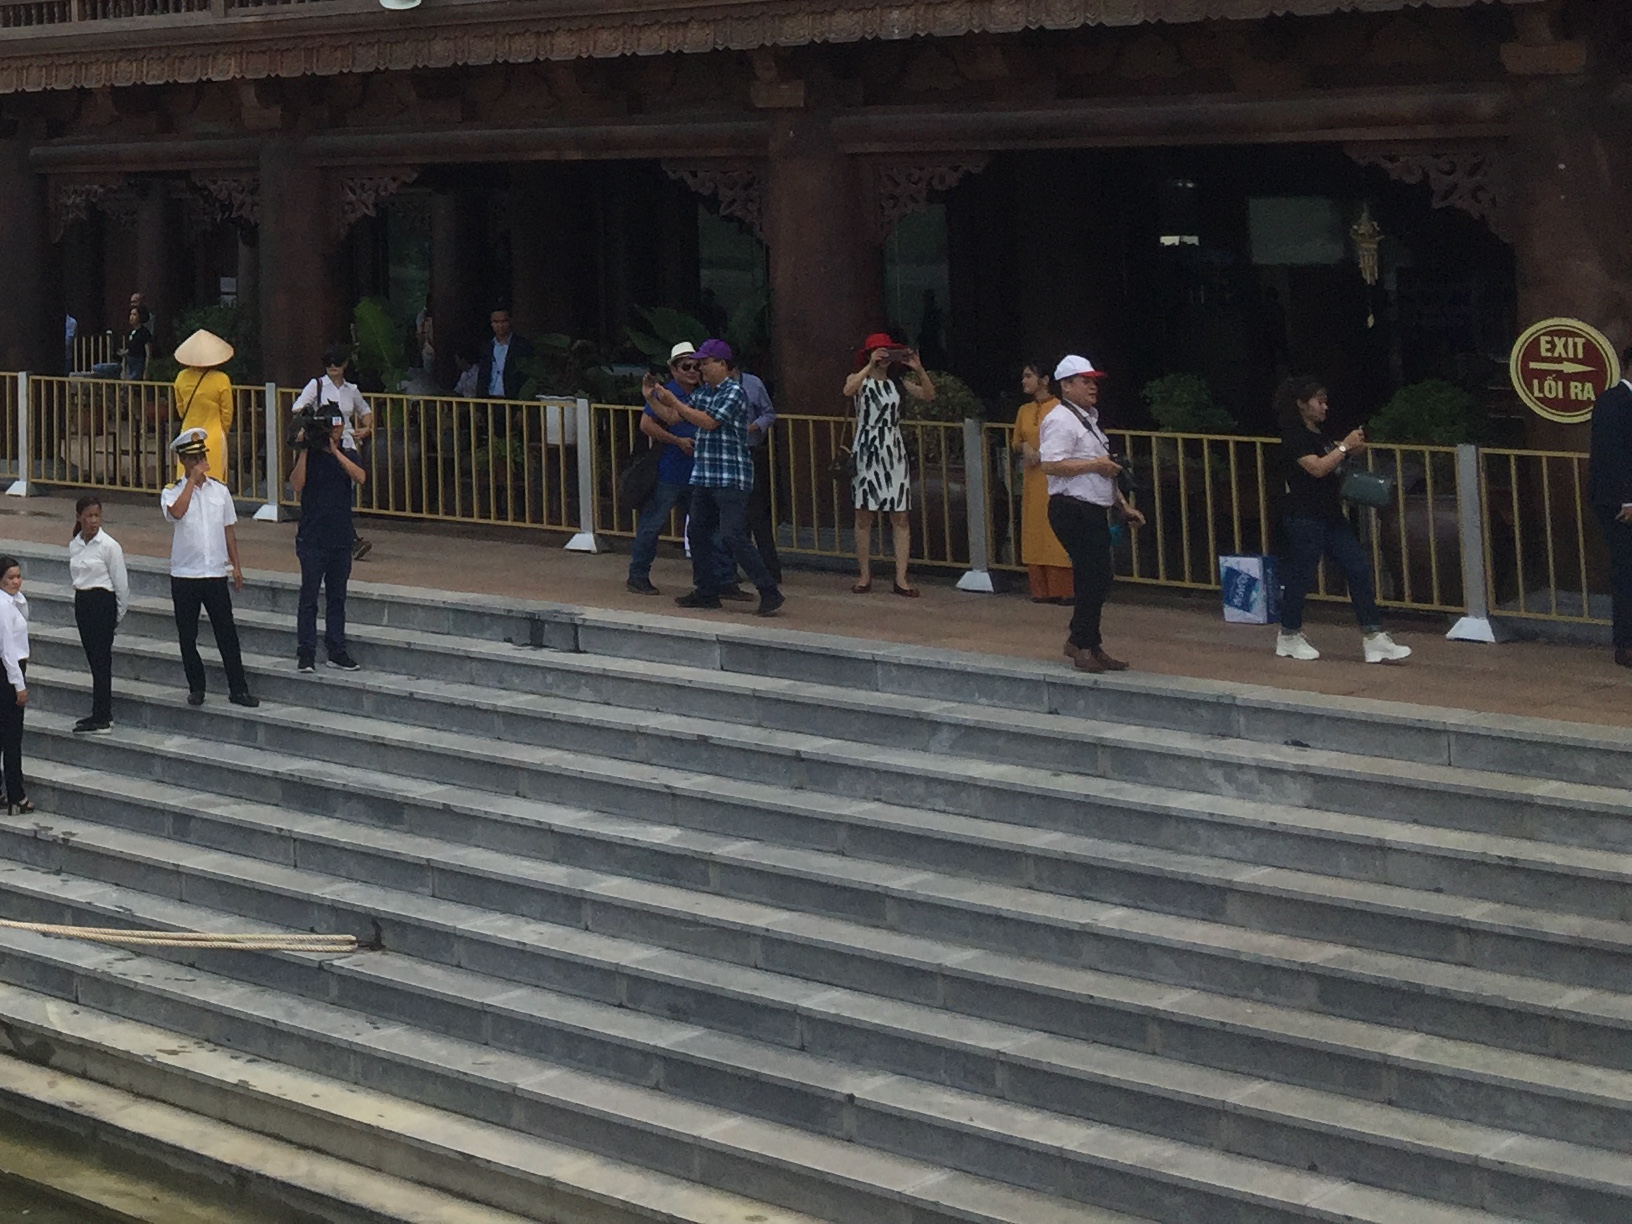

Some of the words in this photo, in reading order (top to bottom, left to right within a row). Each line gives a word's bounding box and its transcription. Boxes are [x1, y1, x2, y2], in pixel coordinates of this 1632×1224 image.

[1539, 335, 1586, 359] EXIT
[1532, 373, 1564, 399] LỐI
[1569, 380, 1596, 401] RA
